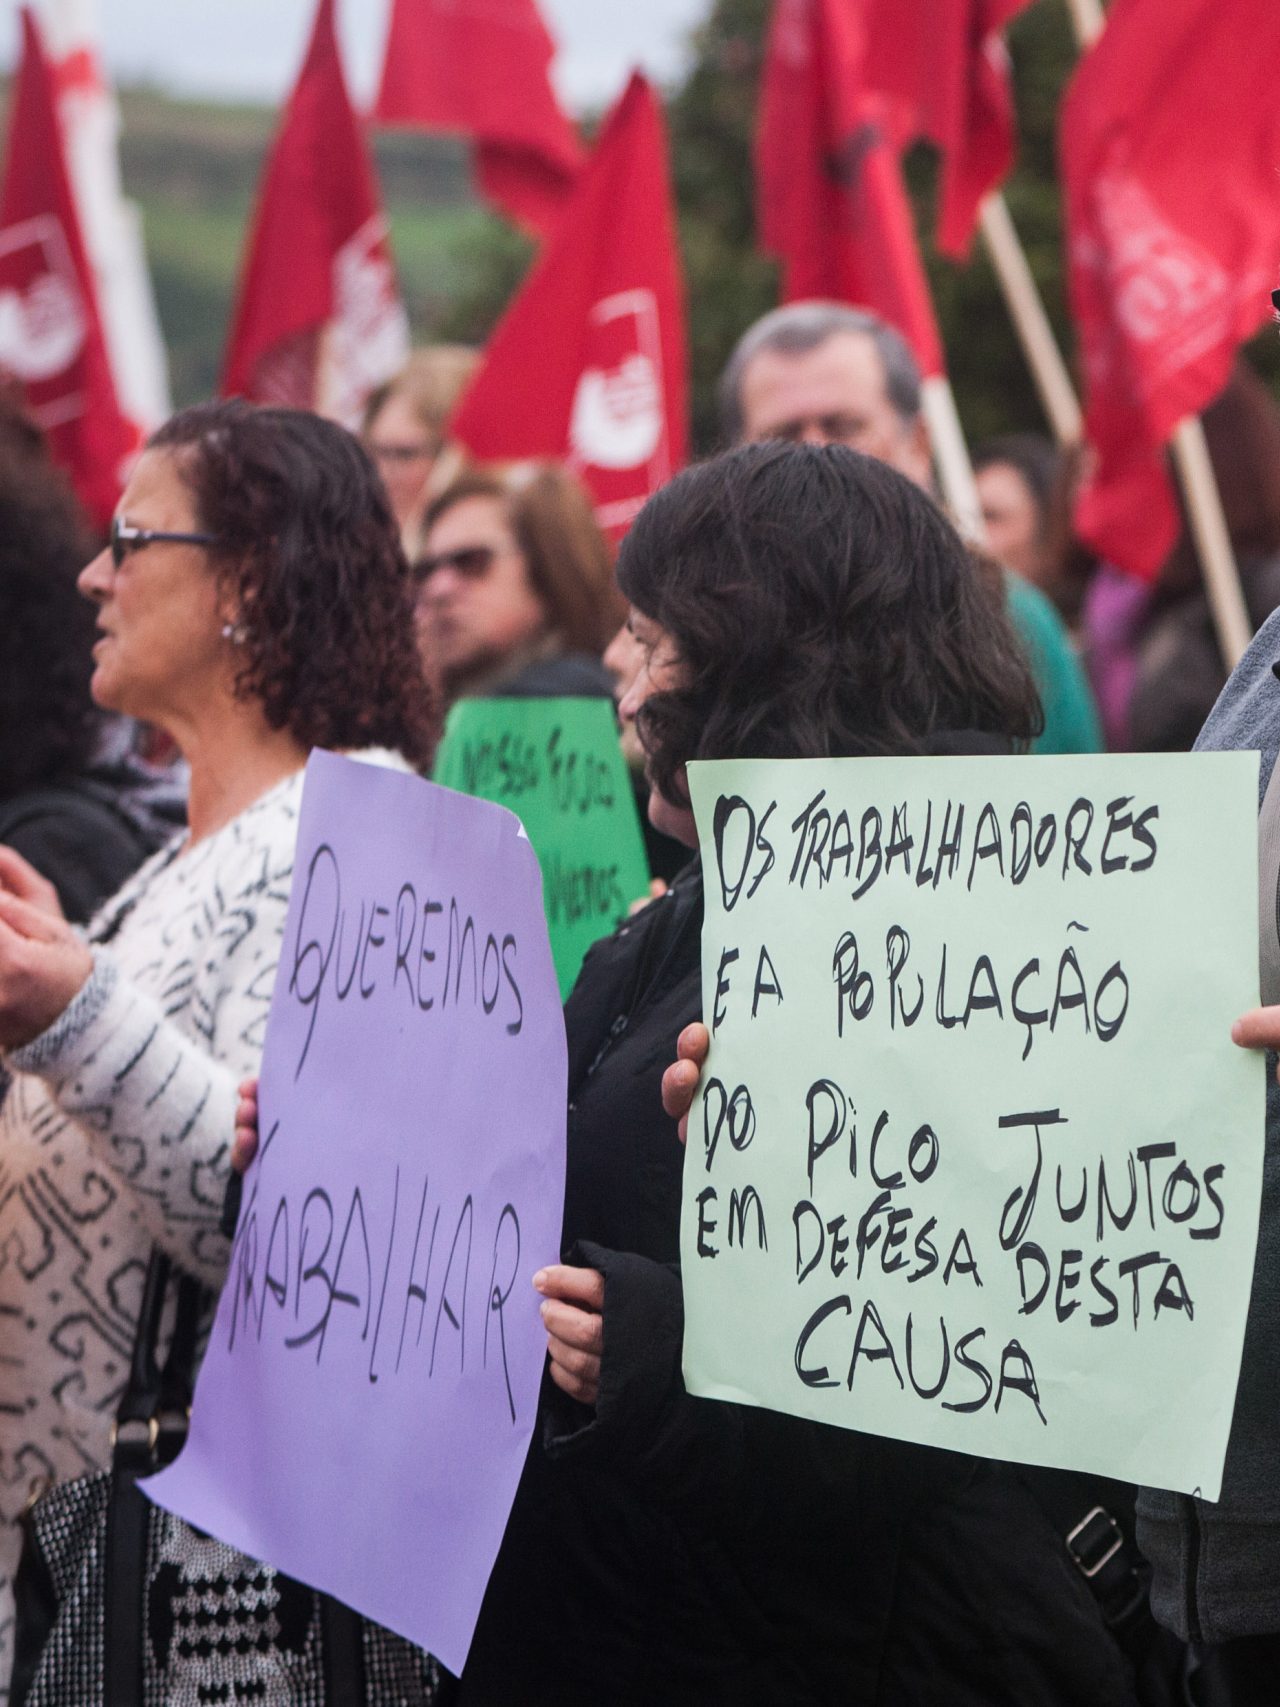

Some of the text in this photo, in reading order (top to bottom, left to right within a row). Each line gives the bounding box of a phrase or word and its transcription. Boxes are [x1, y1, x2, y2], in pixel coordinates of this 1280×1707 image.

[713, 794, 777, 912] OS
[788, 790, 1159, 900] TRABALHADORES
[289, 843, 523, 1082] QUEREMOS
[712, 921, 1129, 1061] E A POPULAÇÃO
[703, 1077, 756, 1172] DO
[998, 1109, 1225, 1250] JUNTOS
[229, 1120, 516, 1425] TRABALHAR
[696, 1185, 1194, 1331] EM DEFESA DESTA
[794, 1295, 1047, 1425] CAUSA
